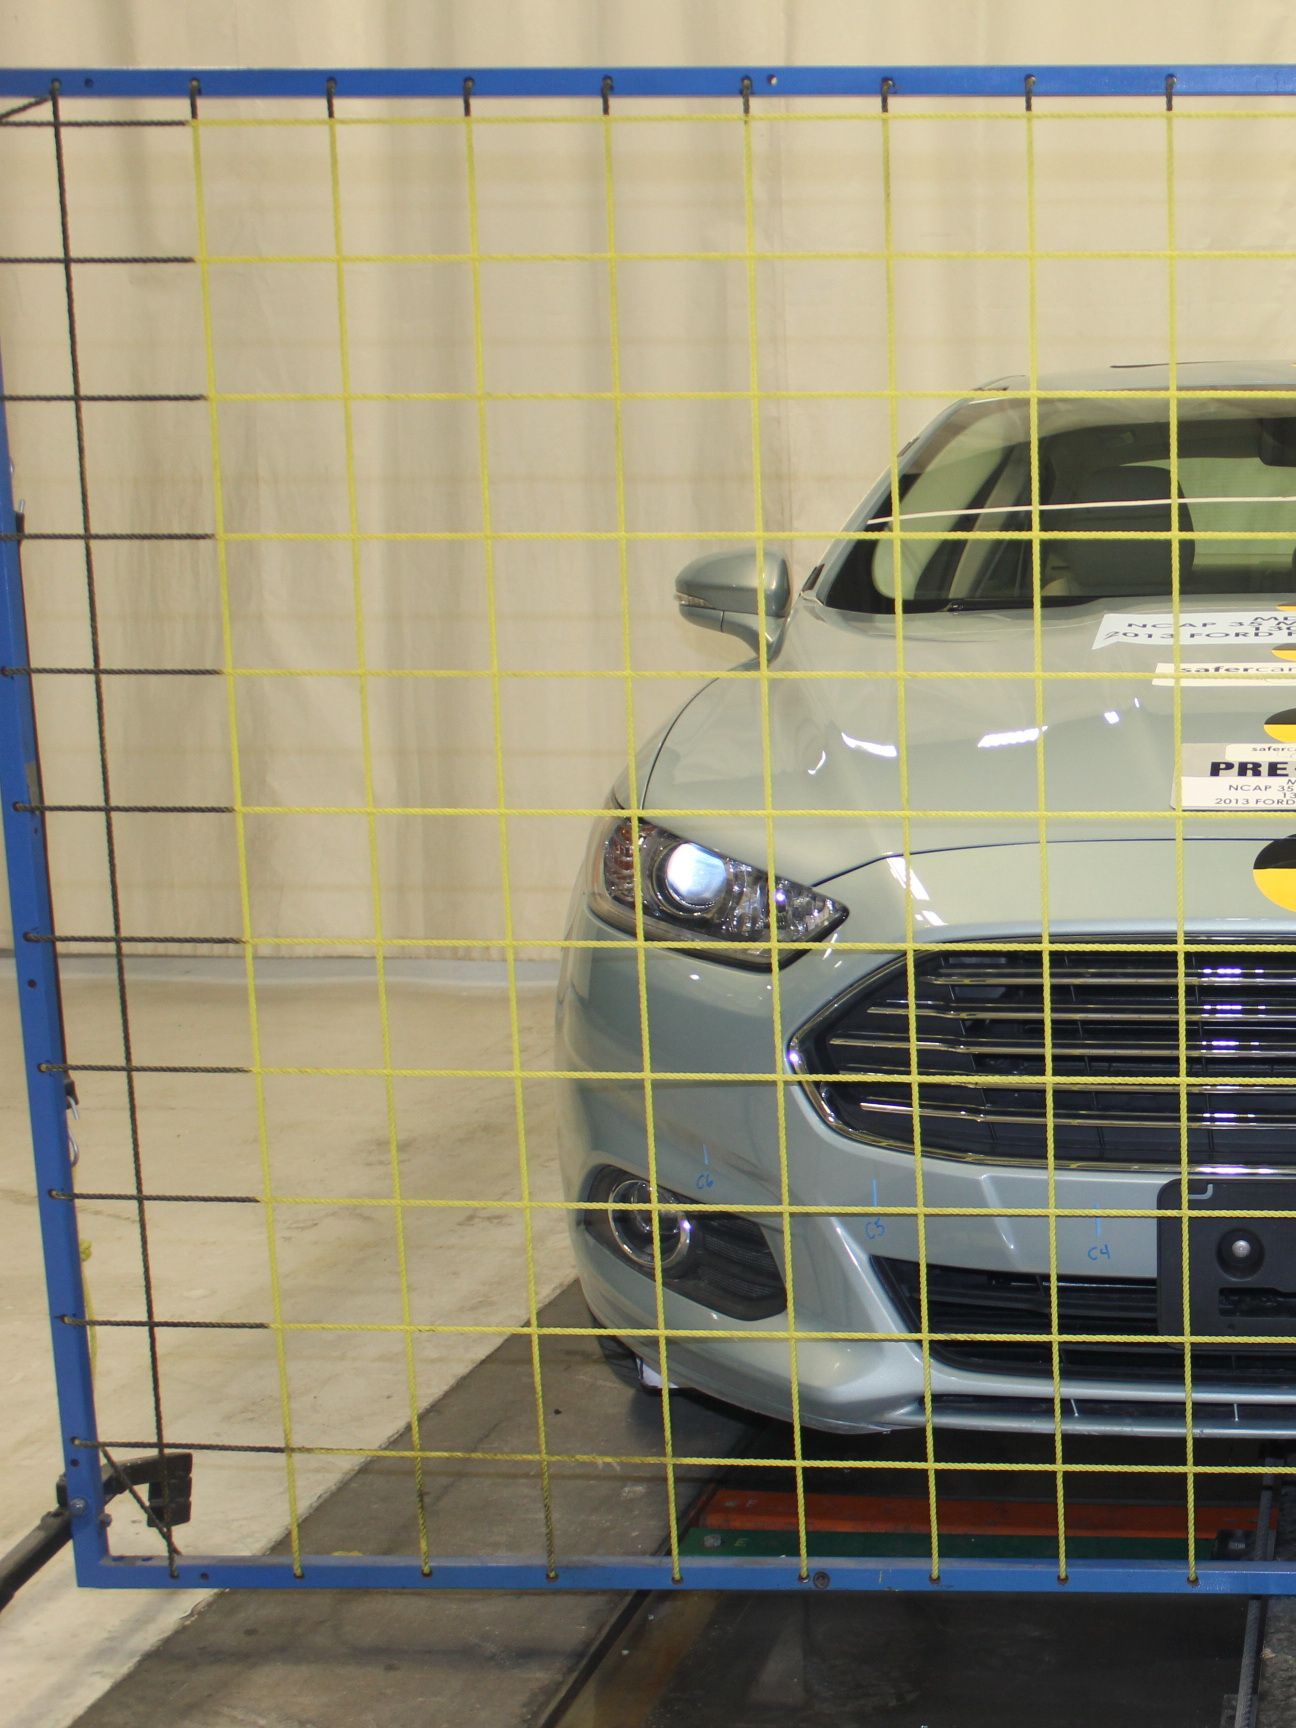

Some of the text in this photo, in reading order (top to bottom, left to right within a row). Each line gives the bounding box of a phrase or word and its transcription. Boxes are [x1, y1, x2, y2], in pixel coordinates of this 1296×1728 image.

[1103, 632, 1174, 640] 2013
[696, 1173, 714, 1190] C6
[865, 1216, 886, 1240] C5
[1087, 1243, 1111, 1261] C4
